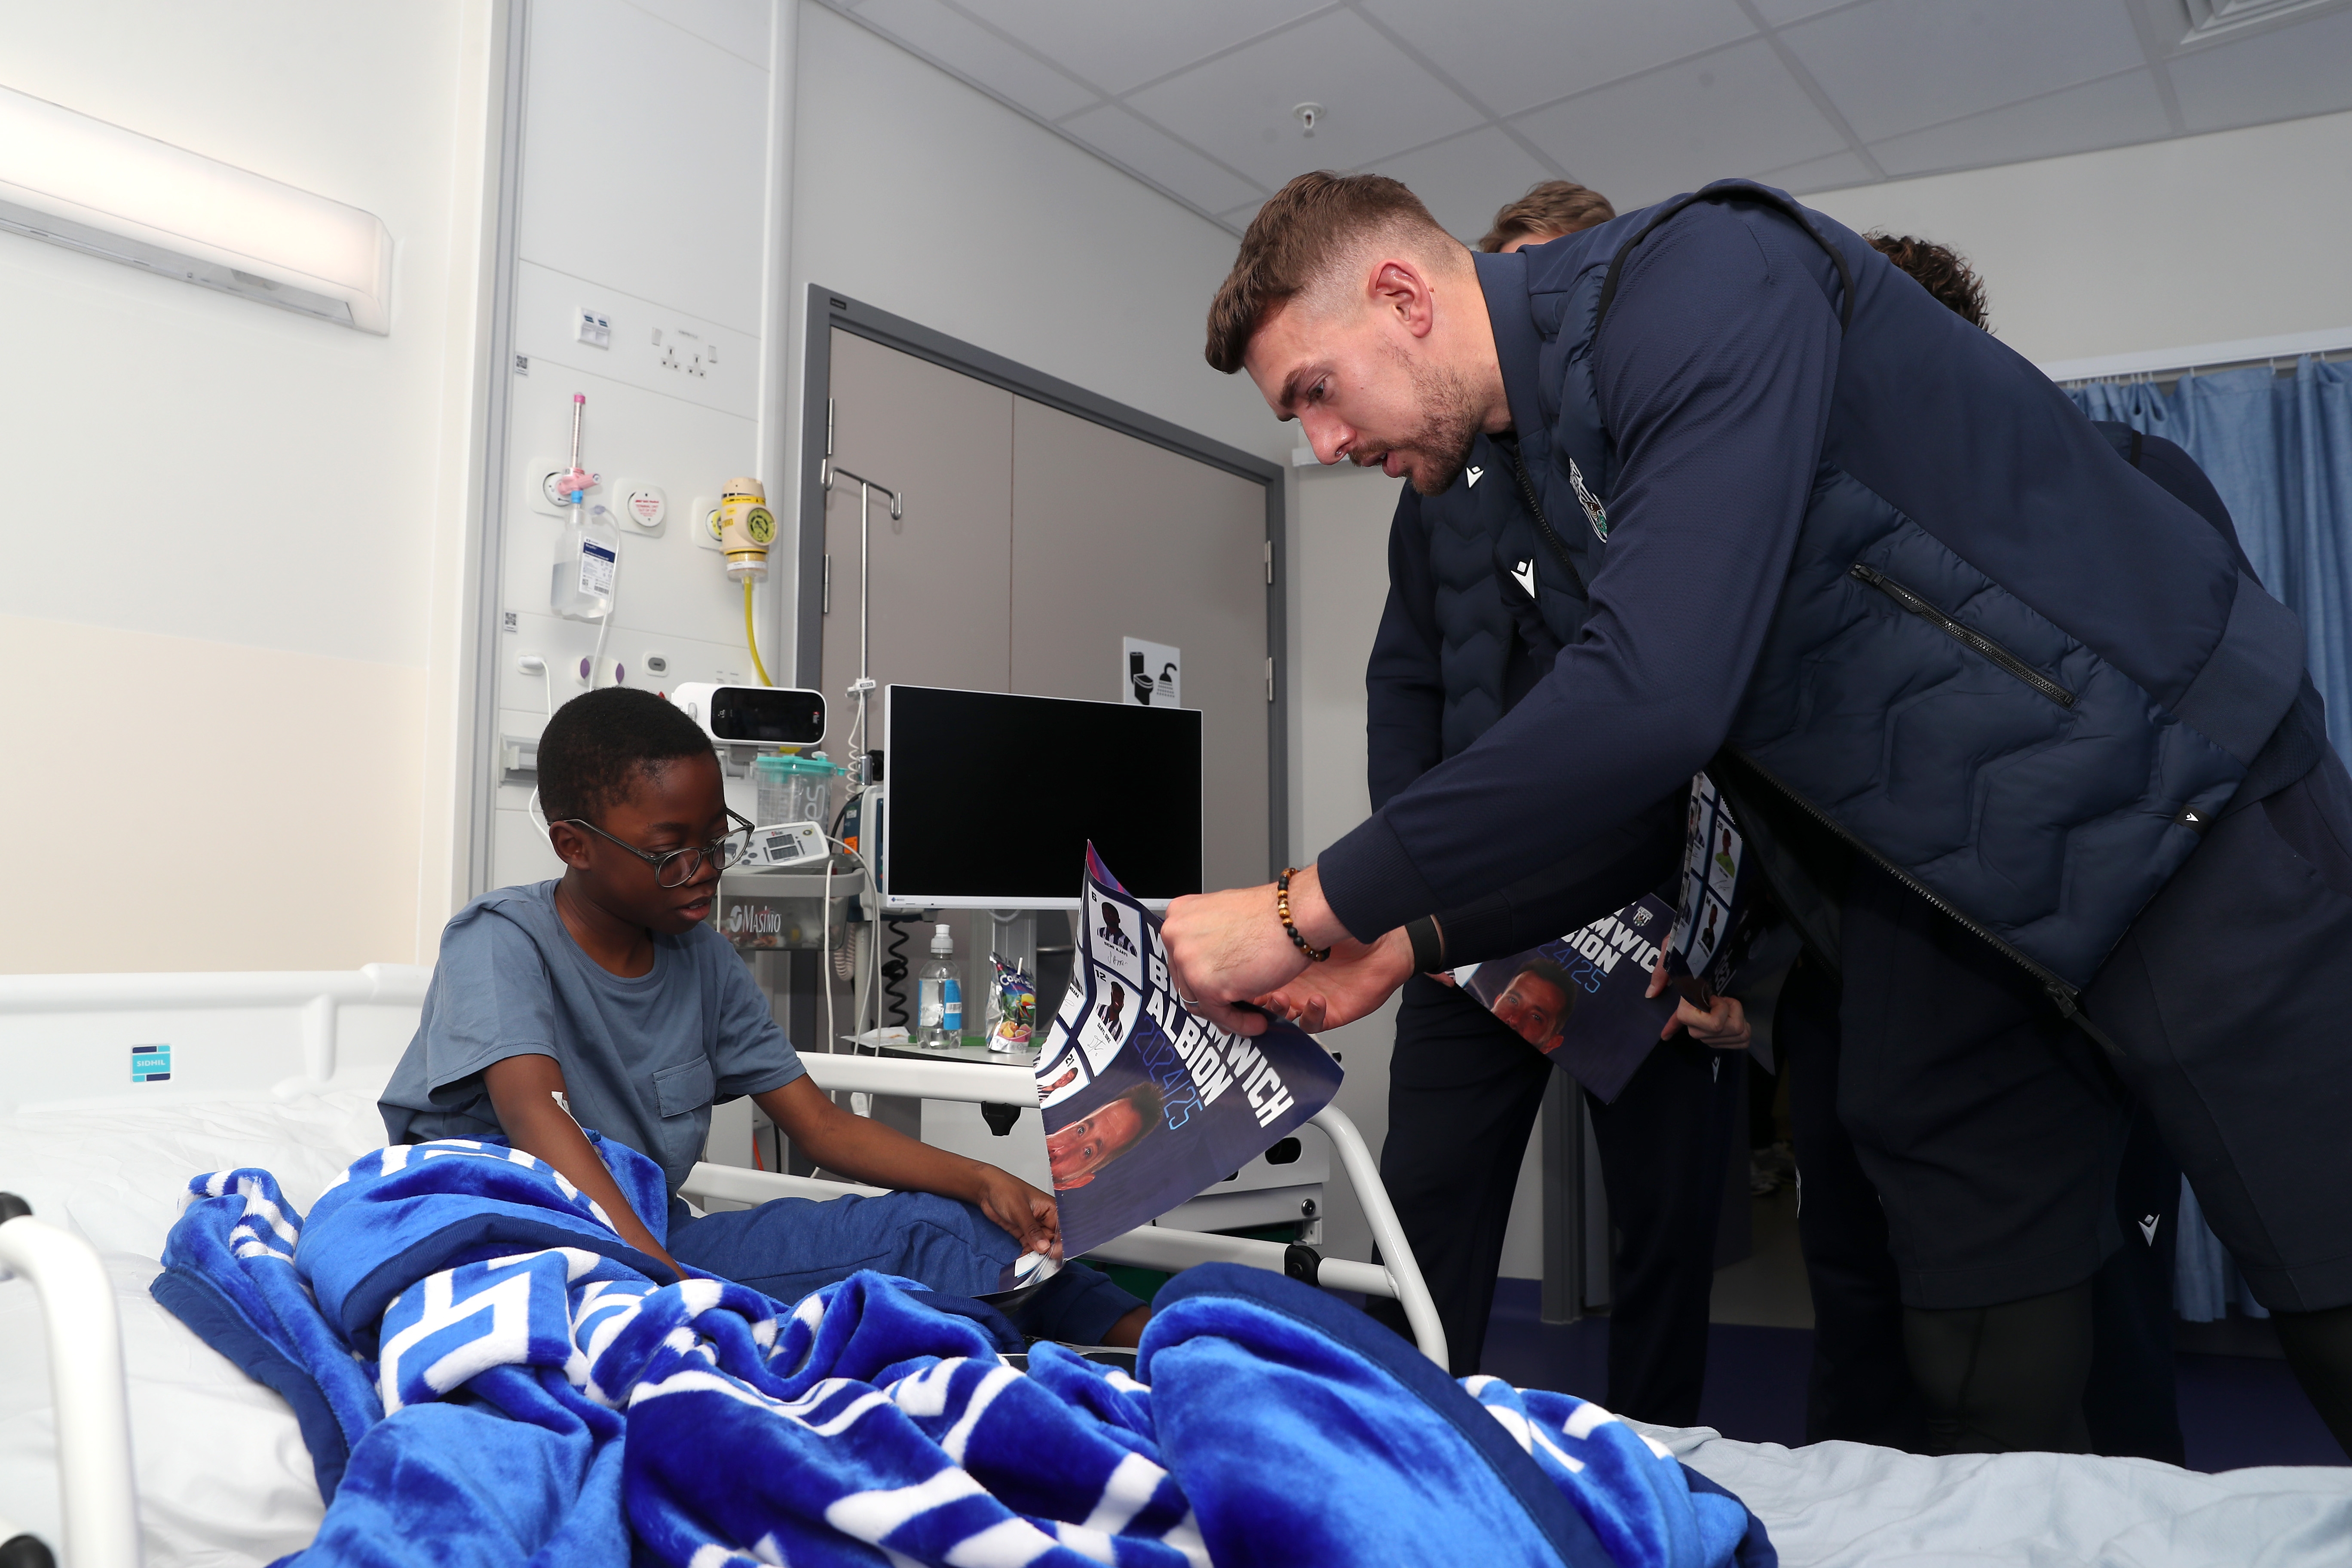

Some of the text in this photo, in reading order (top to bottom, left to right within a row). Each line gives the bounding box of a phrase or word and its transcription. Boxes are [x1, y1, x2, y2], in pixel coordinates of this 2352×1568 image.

[1092, 891, 1097, 902] 6
[1116, 948, 1128, 957] AJAYI
[1587, 916, 1663, 974] MWIC
[1095, 969, 1107, 982] 12
[1537, 940, 1607, 993] 24/25
[1097, 1022, 1106, 1035] DARYL
[1148, 953, 1295, 1128] BMWICH
[1065, 1054, 1075, 1067] 21
[1145, 987, 1234, 1107] ALBION
[1133, 1015, 1203, 1130] 2024/25
